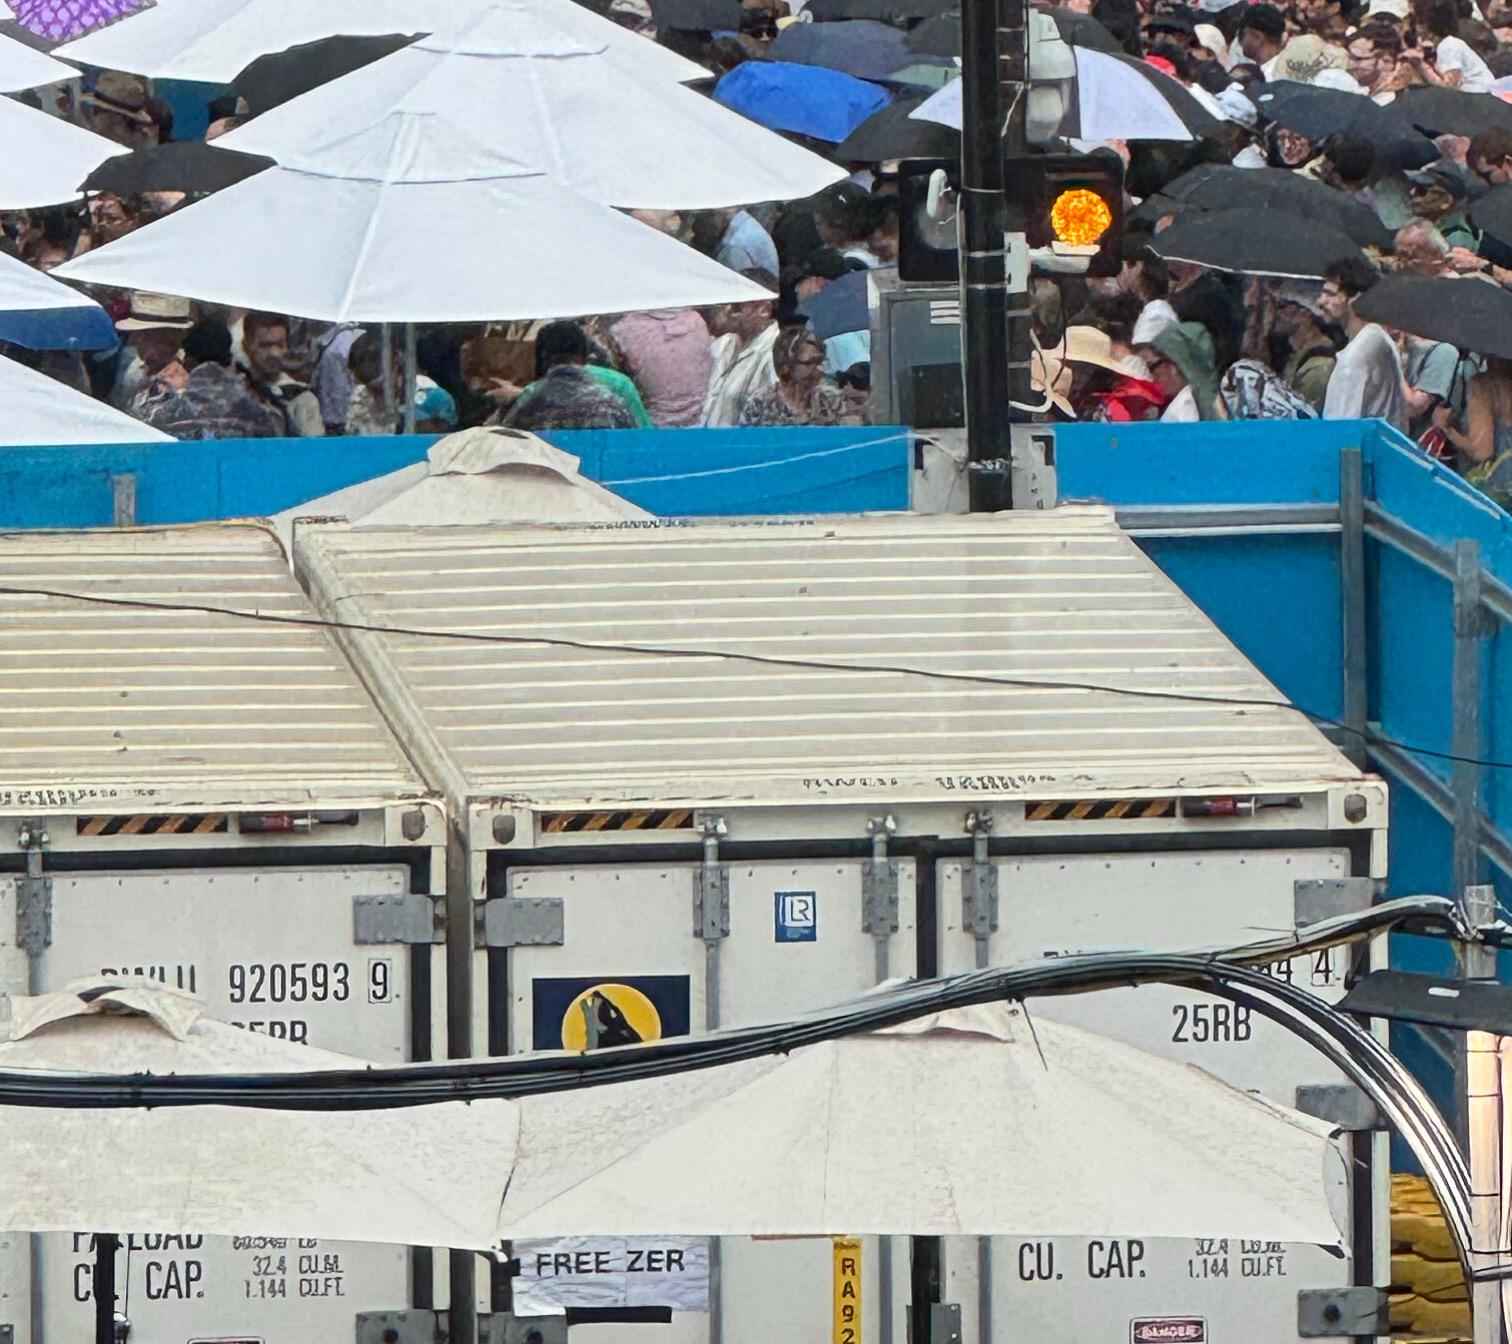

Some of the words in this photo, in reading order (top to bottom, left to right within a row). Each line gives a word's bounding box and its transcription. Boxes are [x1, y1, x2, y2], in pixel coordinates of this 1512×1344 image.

[229, 962, 350, 1003] 920593
[371, 961, 388, 1000] 9
[1172, 1004, 1251, 1043] 25RB
[536, 1251, 616, 1277] FREE
[626, 1249, 686, 1272] ZER
[1018, 1241, 1063, 1280] CU.
[1088, 1239, 1146, 1278] CAP.
[146, 1260, 205, 1300] CAP.
